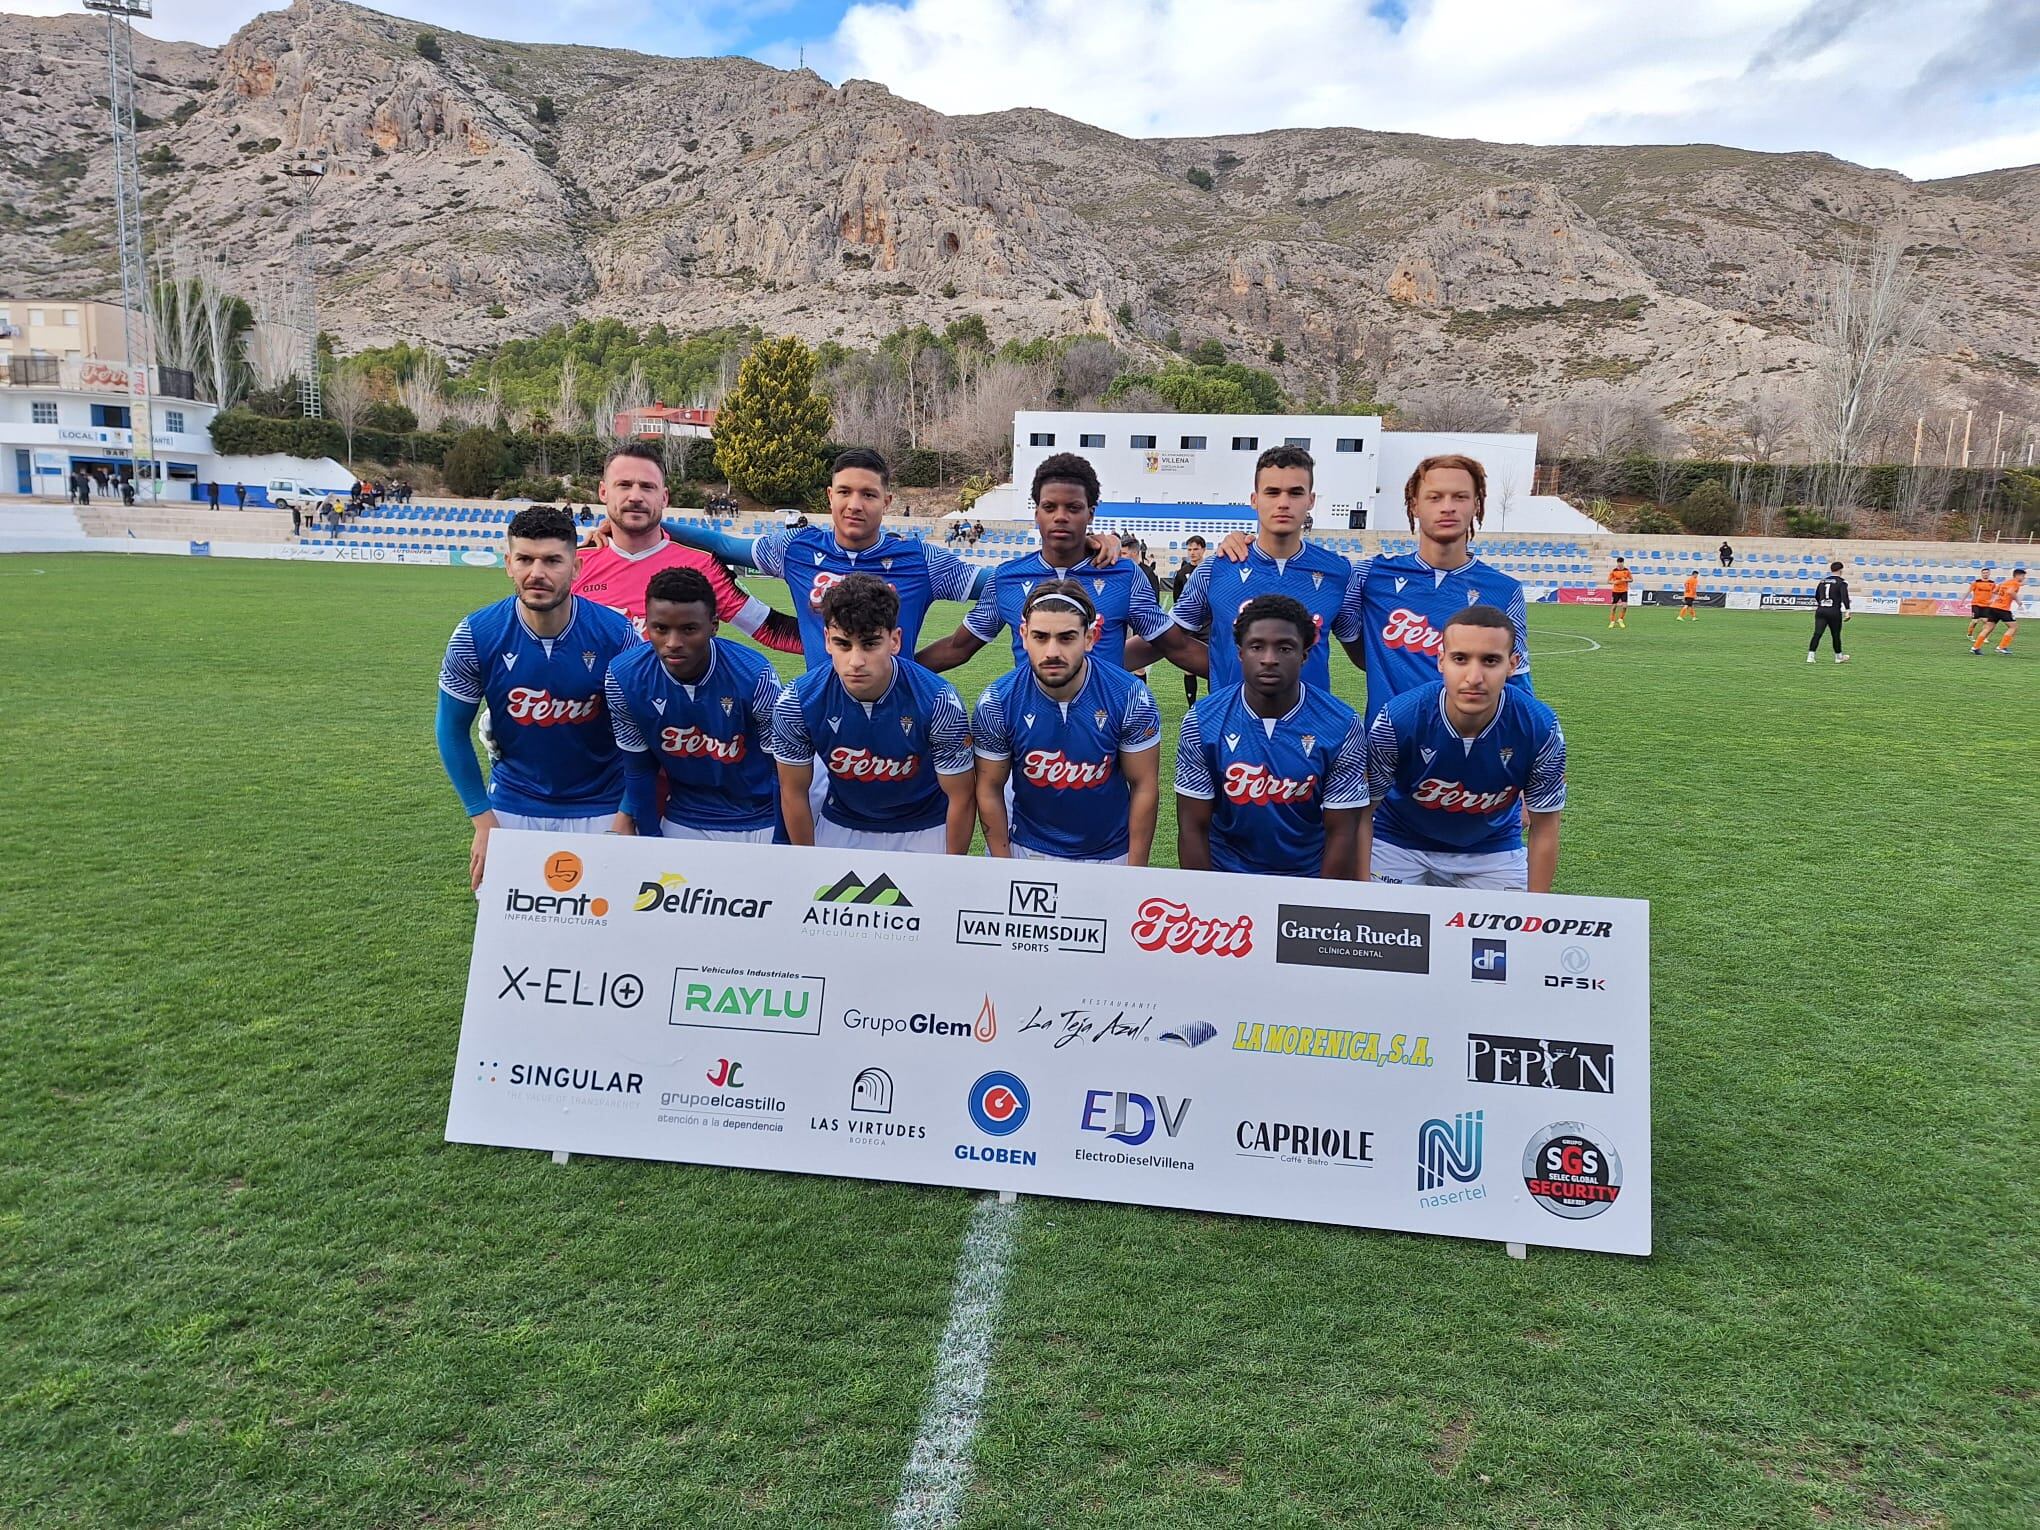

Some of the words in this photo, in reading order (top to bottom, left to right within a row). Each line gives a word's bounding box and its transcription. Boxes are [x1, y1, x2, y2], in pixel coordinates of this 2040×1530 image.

[1383, 608, 1444, 656] Fer
[506, 686, 599, 727] Ferri
[661, 725, 745, 765] Ferri
[828, 746, 919, 783] Ferri
[1023, 749, 1112, 790] Ferri
[1224, 761, 1318, 806] Ferri
[1412, 778, 1519, 815] Ferri
[633, 881, 773, 919] Delfincar
[504, 913, 608, 927] INFRAESTRUCTURAS
[803, 906, 920, 931] Atlántica
[1130, 897, 1253, 959] Ferri
[1445, 911, 1613, 938] AUTODOPER
[800, 927, 868, 939] Agricultura
[874, 931, 920, 942] Natural
[964, 919, 1001, 937] VAN
[1004, 922, 1100, 944] RIEMSDIJK
[1281, 920, 1352, 942] García
[1356, 924, 1423, 947] Rueda
[1011, 942, 1050, 953] SPORTS
[1318, 945, 1351, 956] CLÍNICA
[1352, 949, 1384, 959] DENTAL
[746, 968, 800, 979] Industriales
[1544, 975, 1606, 991] DFSK
[498, 964, 644, 1009] X-ELIO
[685, 983, 810, 1019] RAYLU
[1081, 998, 1158, 1011] RESTAURANTE
[1018, 1005, 1053, 1033] La
[1054, 1009, 1093, 1049] Teja
[1091, 1011, 1153, 1043] Azul
[1232, 1021, 1264, 1051] LA
[509, 1063, 644, 1095] SINGULAR
[661, 1091, 786, 1112] grupoelcastillo
[657, 1114, 699, 1126] atención
[702, 1118, 709, 1126] a
[711, 1117, 720, 1127] la
[722, 1118, 783, 1133] dependencia
[810, 1117, 840, 1132] LAS
[848, 1119, 927, 1139] VIRTUDES
[849, 1137, 887, 1147] BODEGA
[1236, 1120, 1375, 1162] CAPRIOLE
[954, 1144, 1037, 1167] GLOBEN
[1074, 1148, 1195, 1171] ElectroDieselVillena
[1307, 1157, 1329, 1167] Bistro
[1546, 1145, 1599, 1176] SGS
[1528, 1179, 1618, 1202] SECURITY
[1548, 1172, 1570, 1182] SELEC
[1570, 1174, 1599, 1185] GLOBAL
[1419, 1184, 1488, 1209] nasertel
